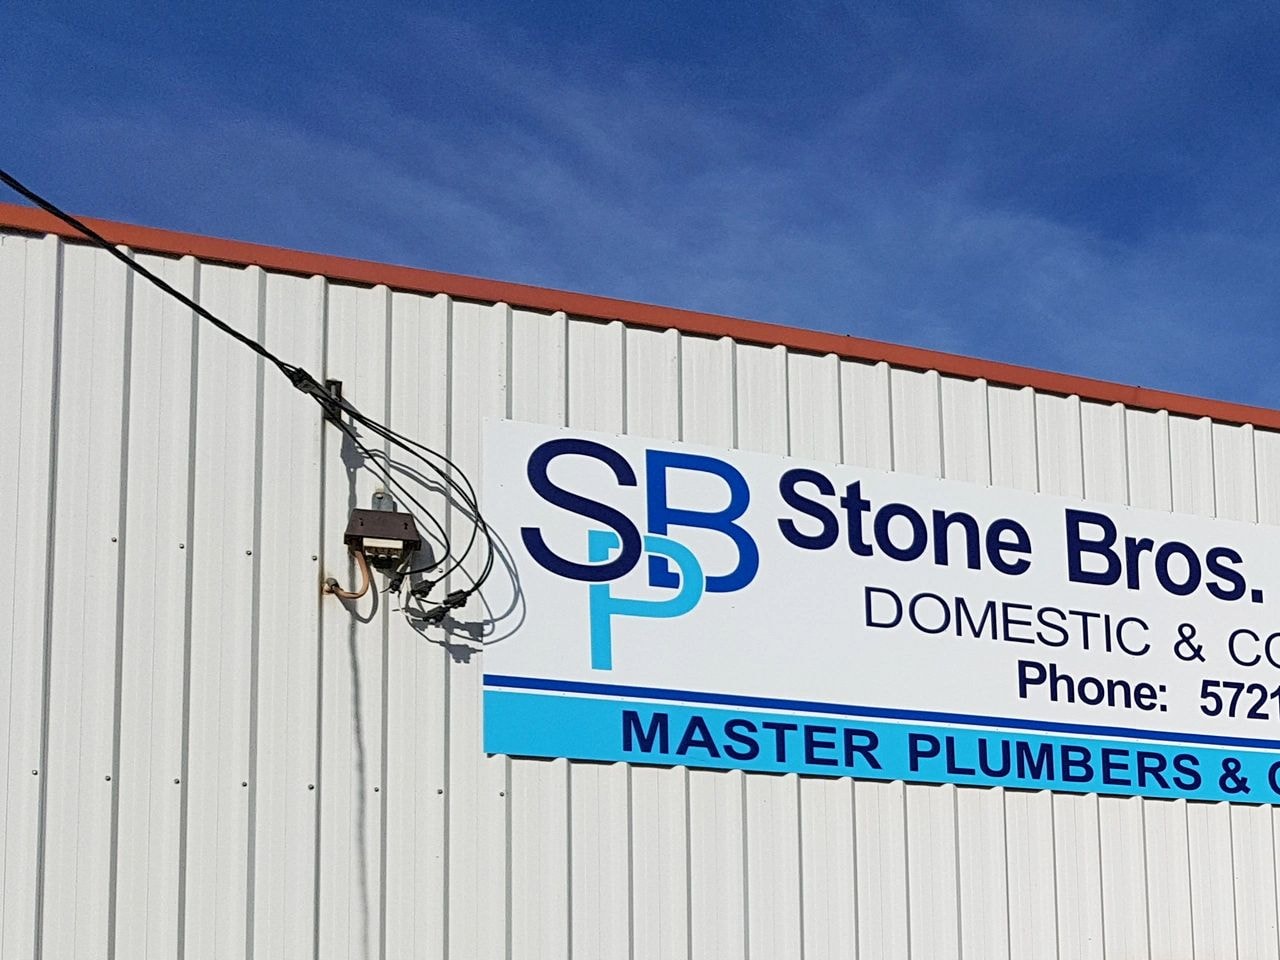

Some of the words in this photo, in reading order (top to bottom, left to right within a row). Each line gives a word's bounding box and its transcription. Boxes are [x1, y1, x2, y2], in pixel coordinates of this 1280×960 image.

[778, 468, 1032, 576] Stone
[1065, 508, 1264, 604] Bros.
[865, 586, 1151, 657] DOMESTIC
[1174, 622, 1206, 663] &
[1017, 659, 1168, 712] Phone:
[622, 709, 883, 770] MASTER
[908, 732, 1202, 791] PLUMBERS
[1218, 757, 1252, 795] &
